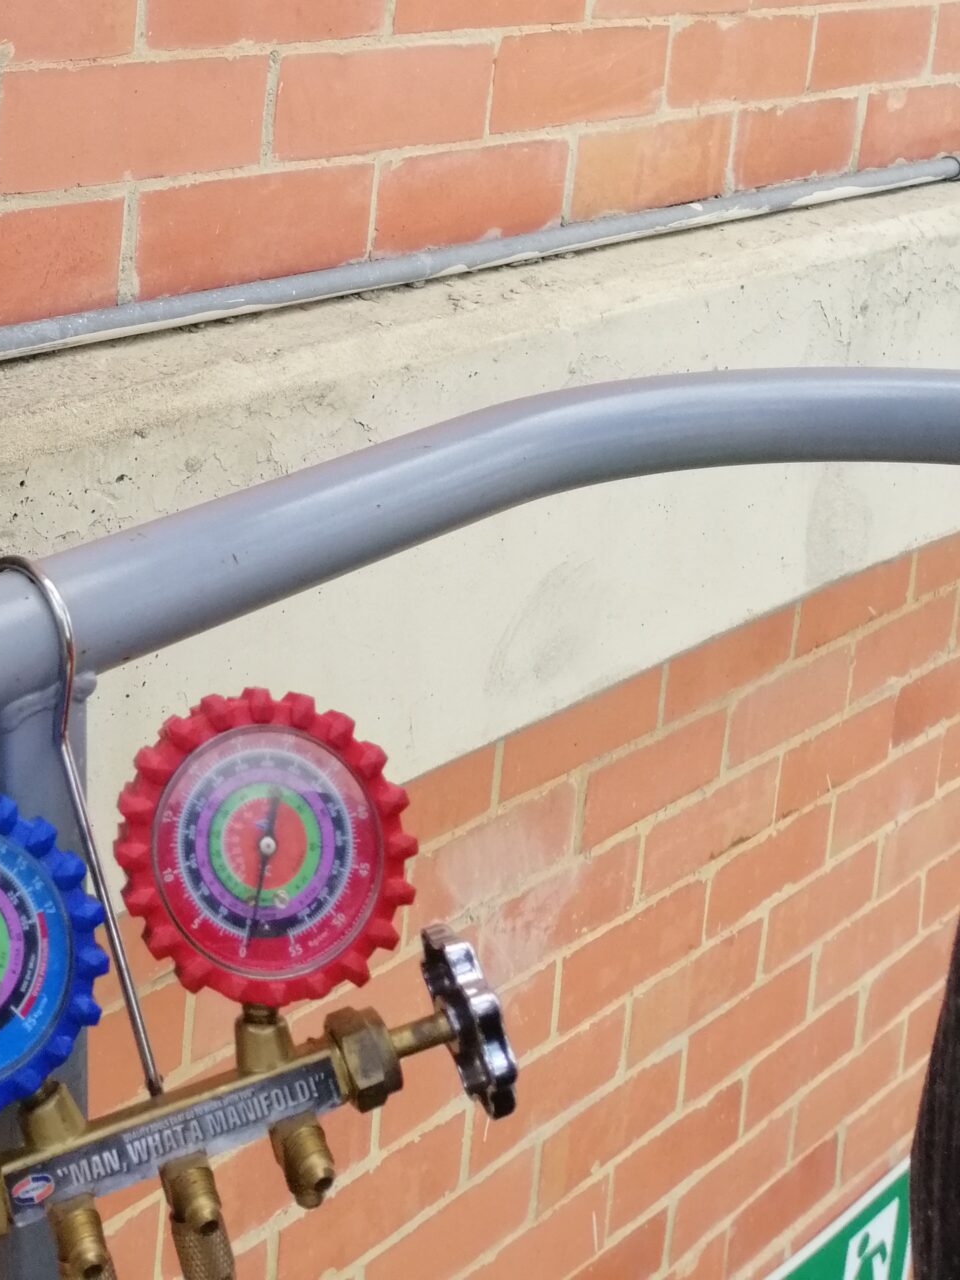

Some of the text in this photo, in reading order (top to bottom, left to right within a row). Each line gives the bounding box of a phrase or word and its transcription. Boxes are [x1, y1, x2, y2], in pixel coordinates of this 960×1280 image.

[162, 868, 174, 882] 10
[239, 946, 247, 958] 0
[288, 944, 303, 957] 55
[129, 1127, 187, 1164] WHAT
[187, 1121, 204, 1143] A
